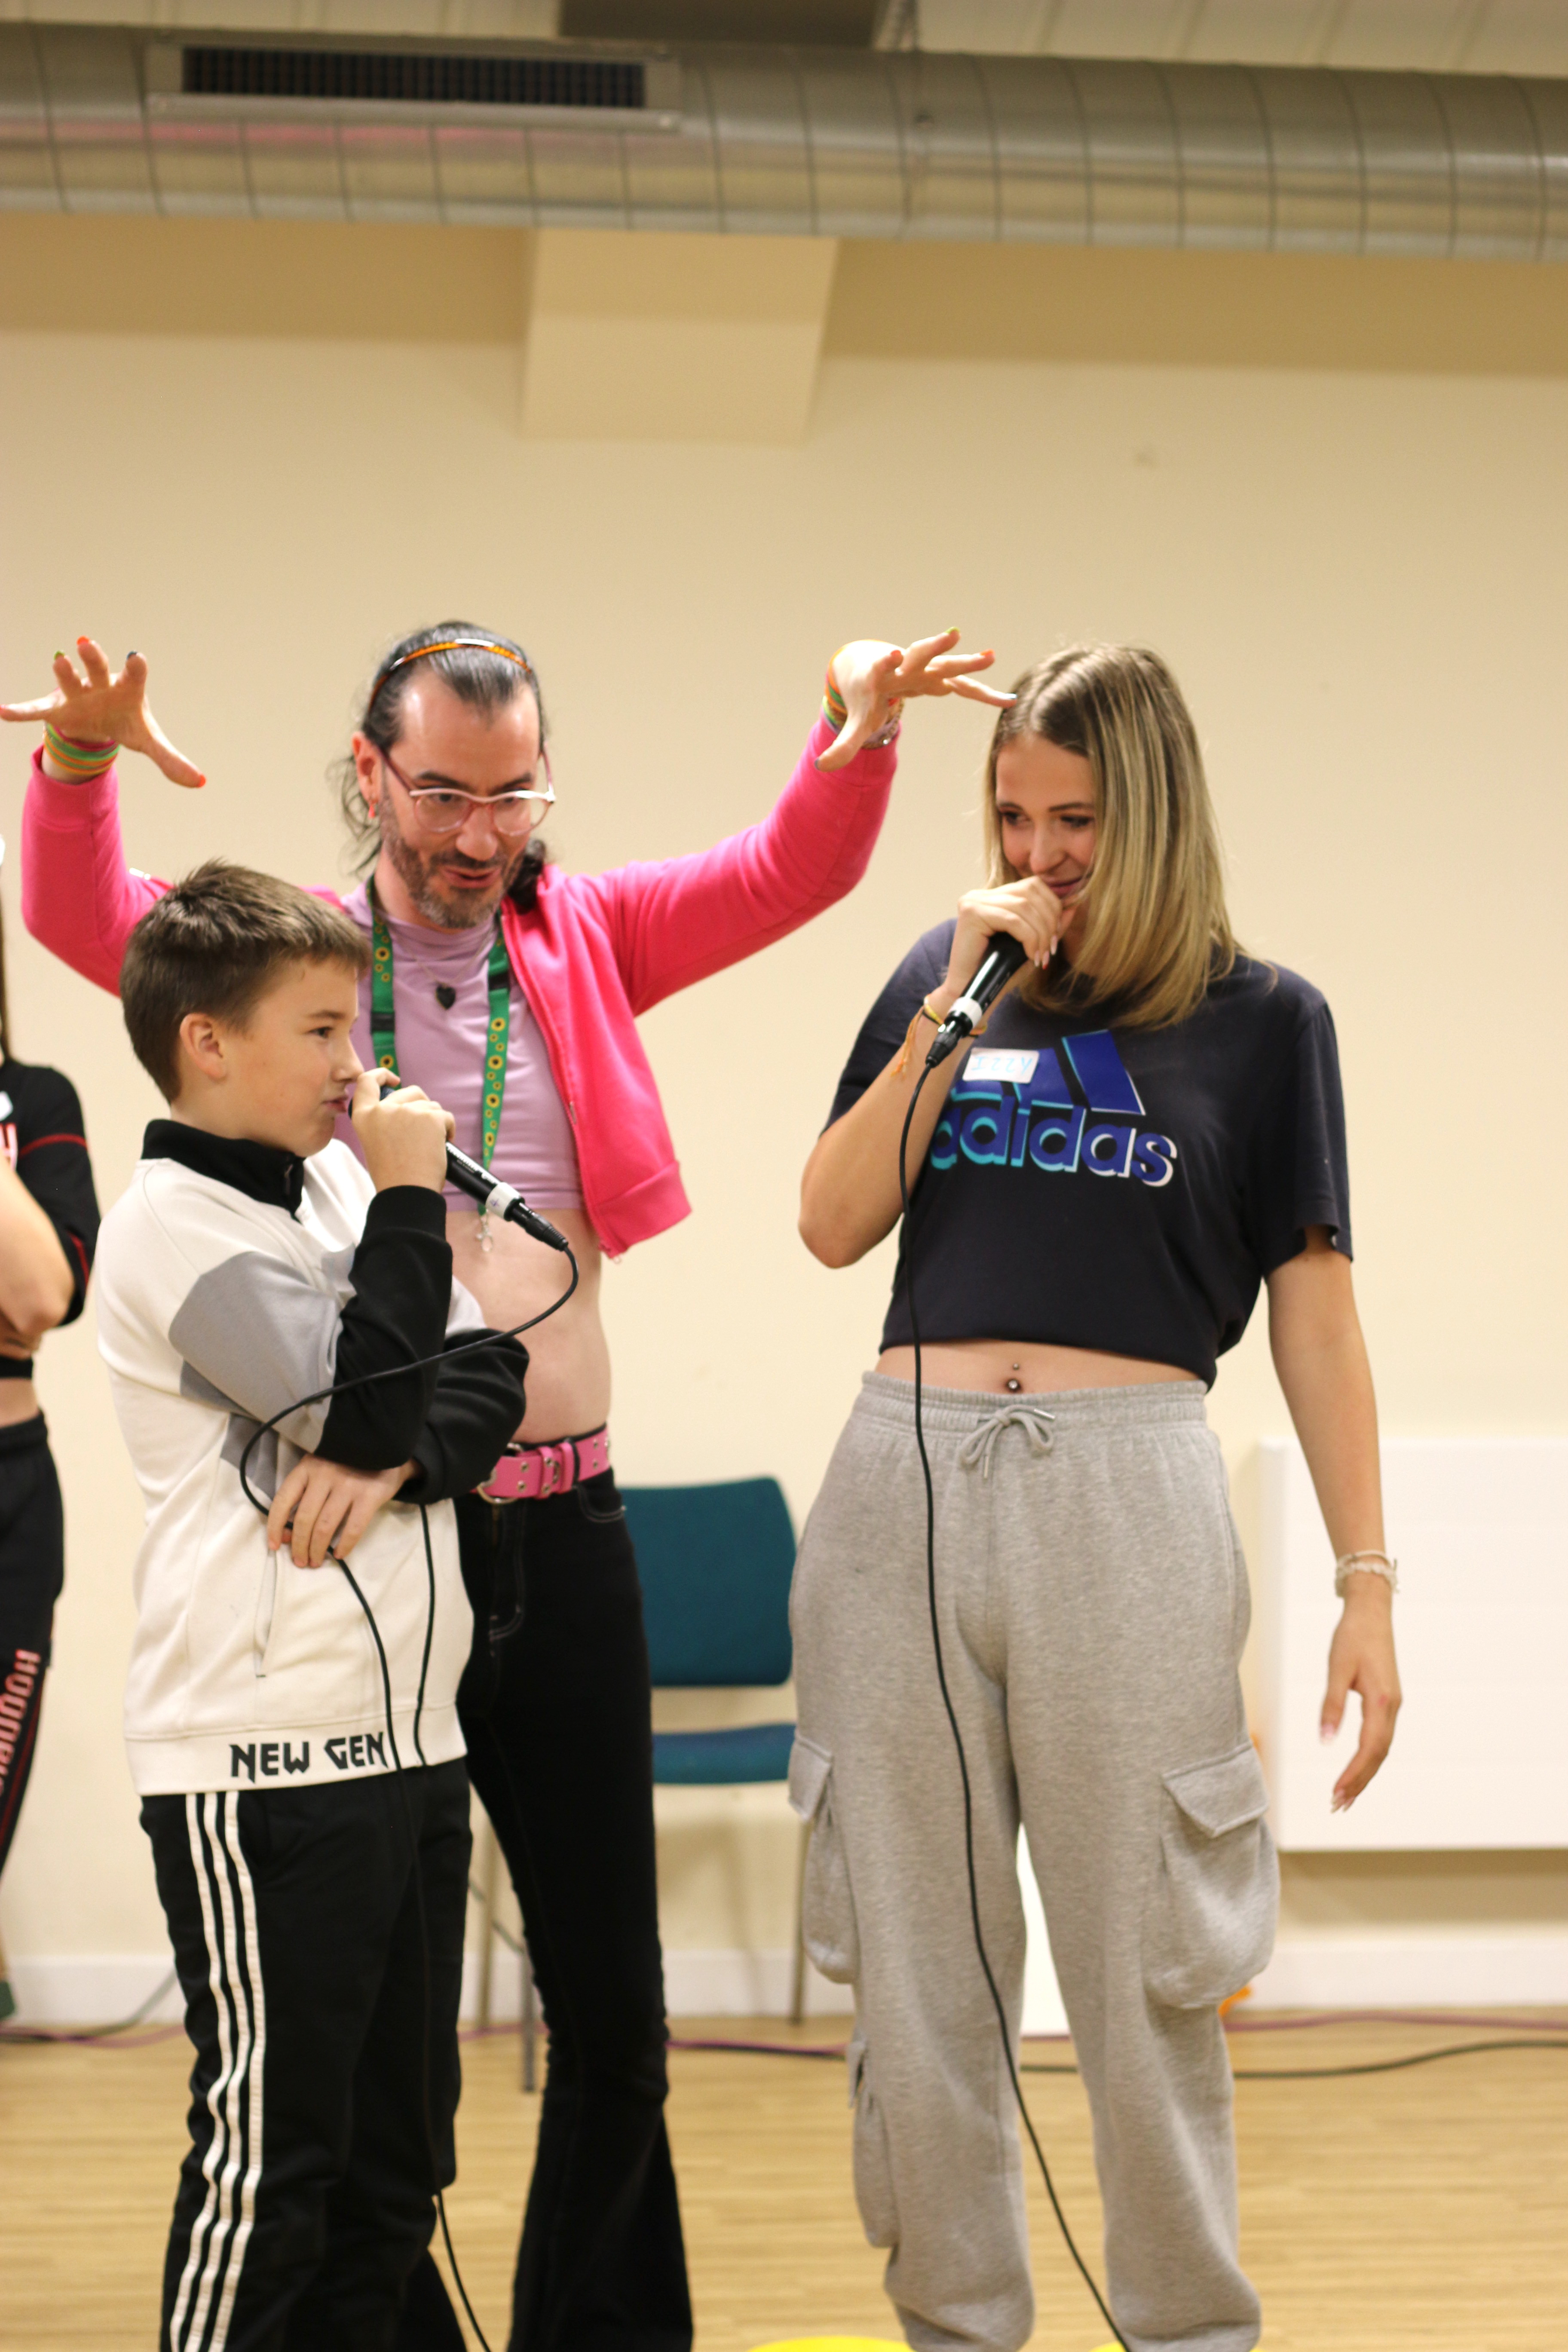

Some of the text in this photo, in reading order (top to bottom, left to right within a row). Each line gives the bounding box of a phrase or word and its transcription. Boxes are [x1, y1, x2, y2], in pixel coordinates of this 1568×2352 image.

[931, 1095, 1177, 1187] adidas
[229, 1731, 389, 1784] NEW GEN
